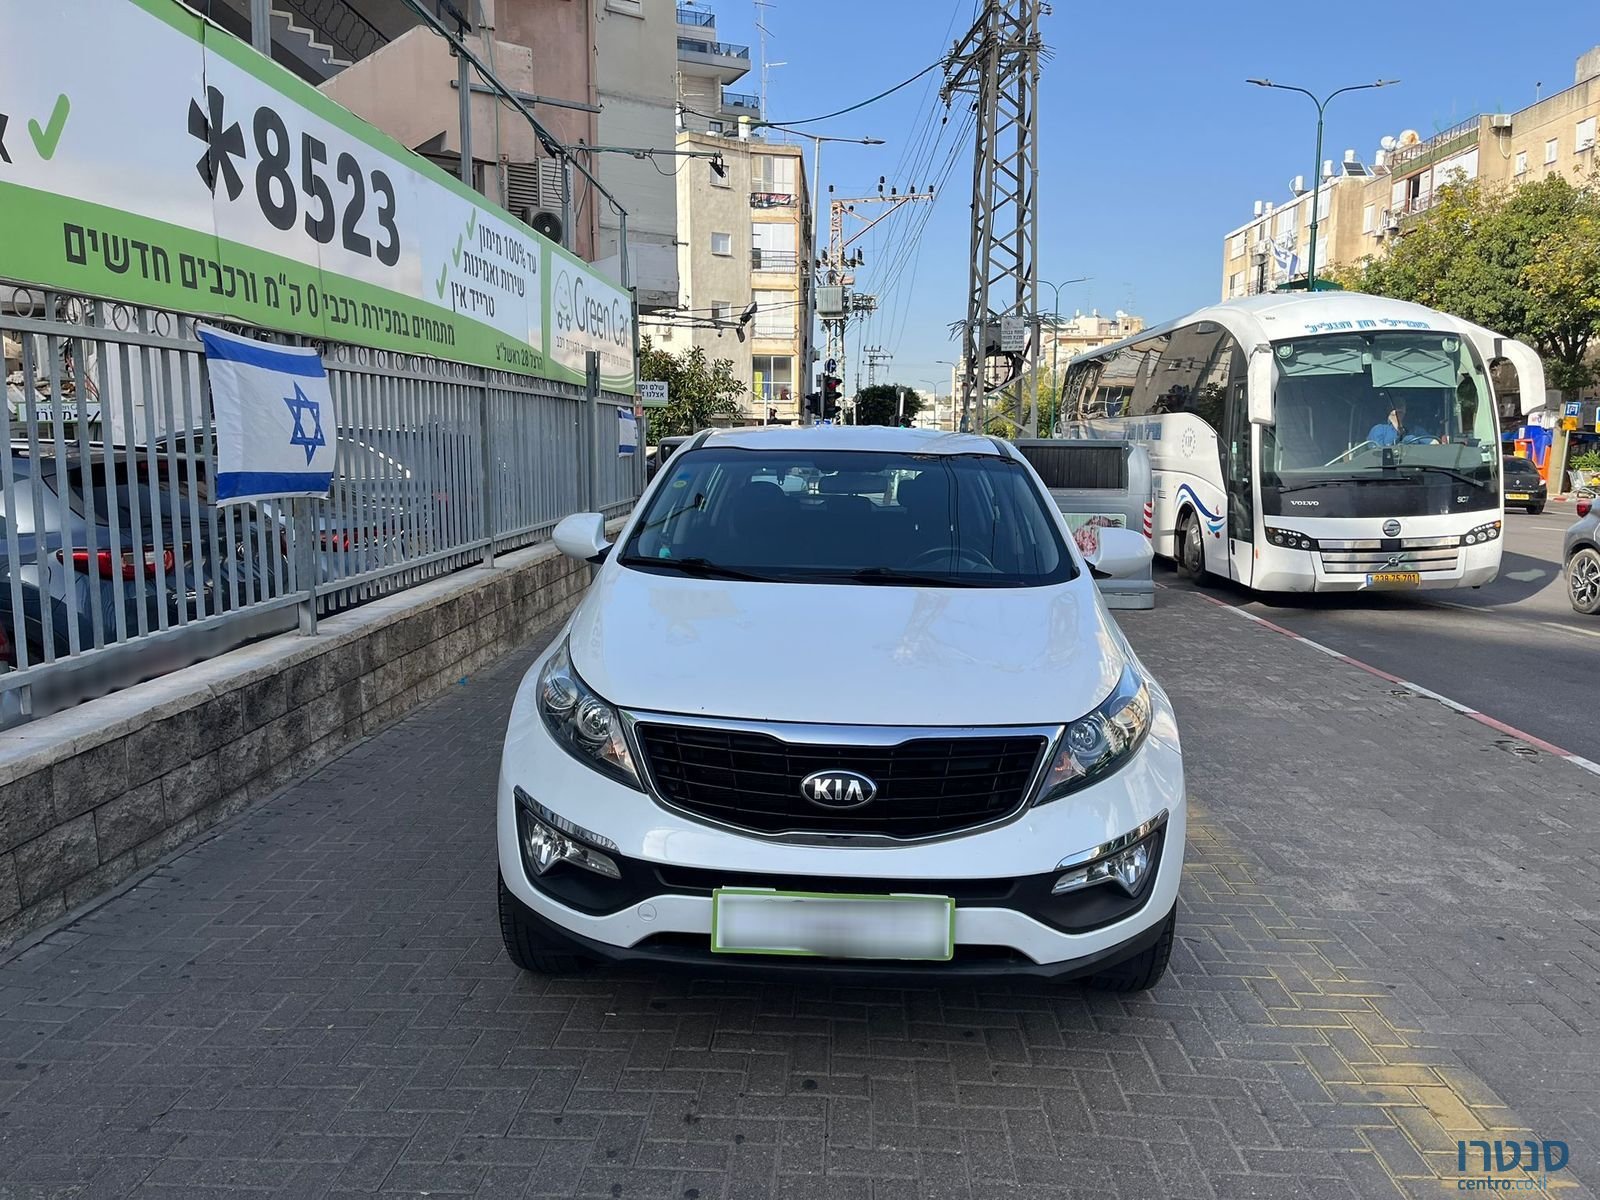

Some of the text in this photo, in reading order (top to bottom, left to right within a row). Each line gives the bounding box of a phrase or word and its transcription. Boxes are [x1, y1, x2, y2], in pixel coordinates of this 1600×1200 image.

[63, 222, 171, 284] חדשים
[479, 223, 537, 275] עד 100% מימון
[179, 253, 258, 304] ורכבים
[463, 250, 525, 298] שירות ואמינות
[307, 283, 319, 318] 0
[323, 293, 358, 326] רכבי
[451, 281, 495, 318] טרייד אין
[575, 277, 629, 349] Green Car
[361, 303, 410, 336] במכירת
[412, 315, 455, 346] מתמחים
[521, 349, 529, 366] 28
[812, 777, 864, 801] KIA
